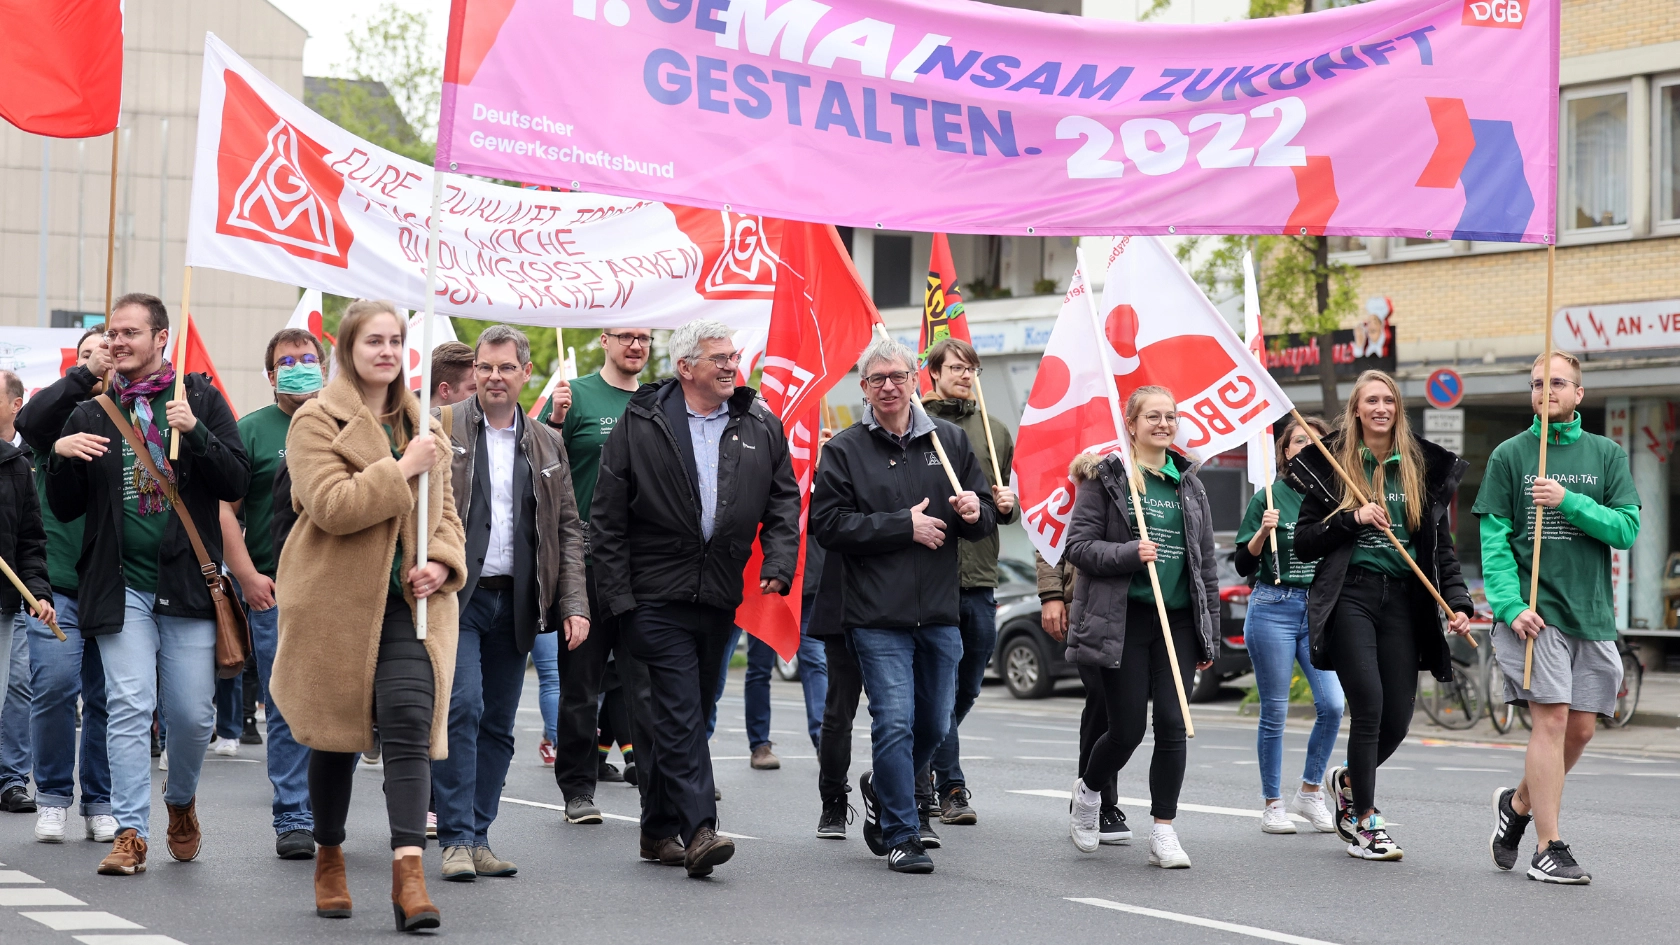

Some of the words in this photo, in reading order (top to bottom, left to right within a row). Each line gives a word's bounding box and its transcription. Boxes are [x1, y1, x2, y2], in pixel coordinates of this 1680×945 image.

[1469, 0, 1523, 23] DGB
[1139, 25, 1437, 102] ZUKUNFT
[472, 103, 574, 137] Deutscher
[643, 48, 1043, 158] GESTALTEN.
[1055, 96, 1308, 179] 2022
[469, 131, 674, 179] Gewerkschaftsbund
[331, 147, 422, 199] EURE
[465, 228, 585, 257] WOCHE
[507, 279, 635, 310] AACHEN
[1616, 317, 1642, 336] AN
